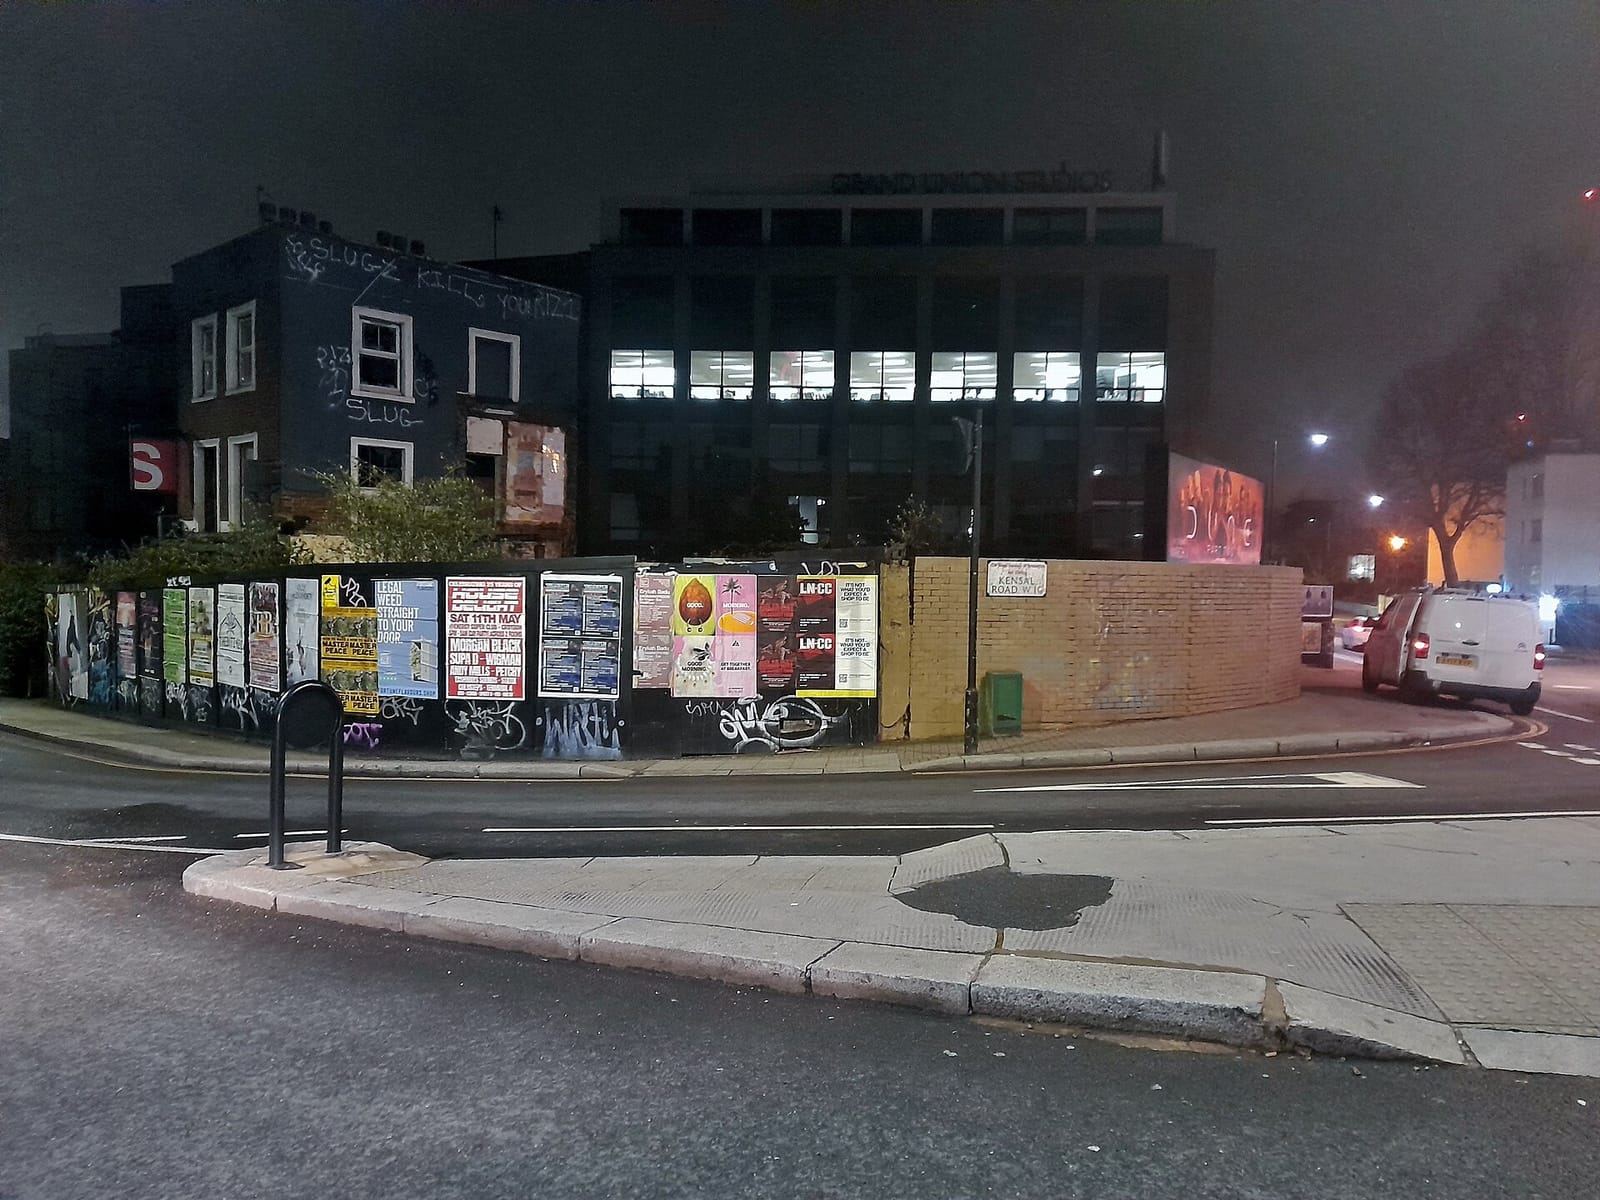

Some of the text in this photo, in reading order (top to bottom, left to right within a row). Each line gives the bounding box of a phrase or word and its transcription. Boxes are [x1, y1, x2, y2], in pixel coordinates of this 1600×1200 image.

[345, 398, 424, 427] SLUG
[998, 576, 1035, 585] KENSAL
[377, 581, 403, 594] LEGAL
[991, 586, 1018, 594] ROAD
[377, 594, 401, 607] WEED
[377, 607, 419, 619] STRAIGHT
[449, 614, 521, 624] SAT 11TH MAY
[377, 619, 413, 632] TO YOUR
[450, 638, 521, 653] MORGAN BLACK
[449, 653, 470, 665] SUPA
[471, 653, 479, 665] D
